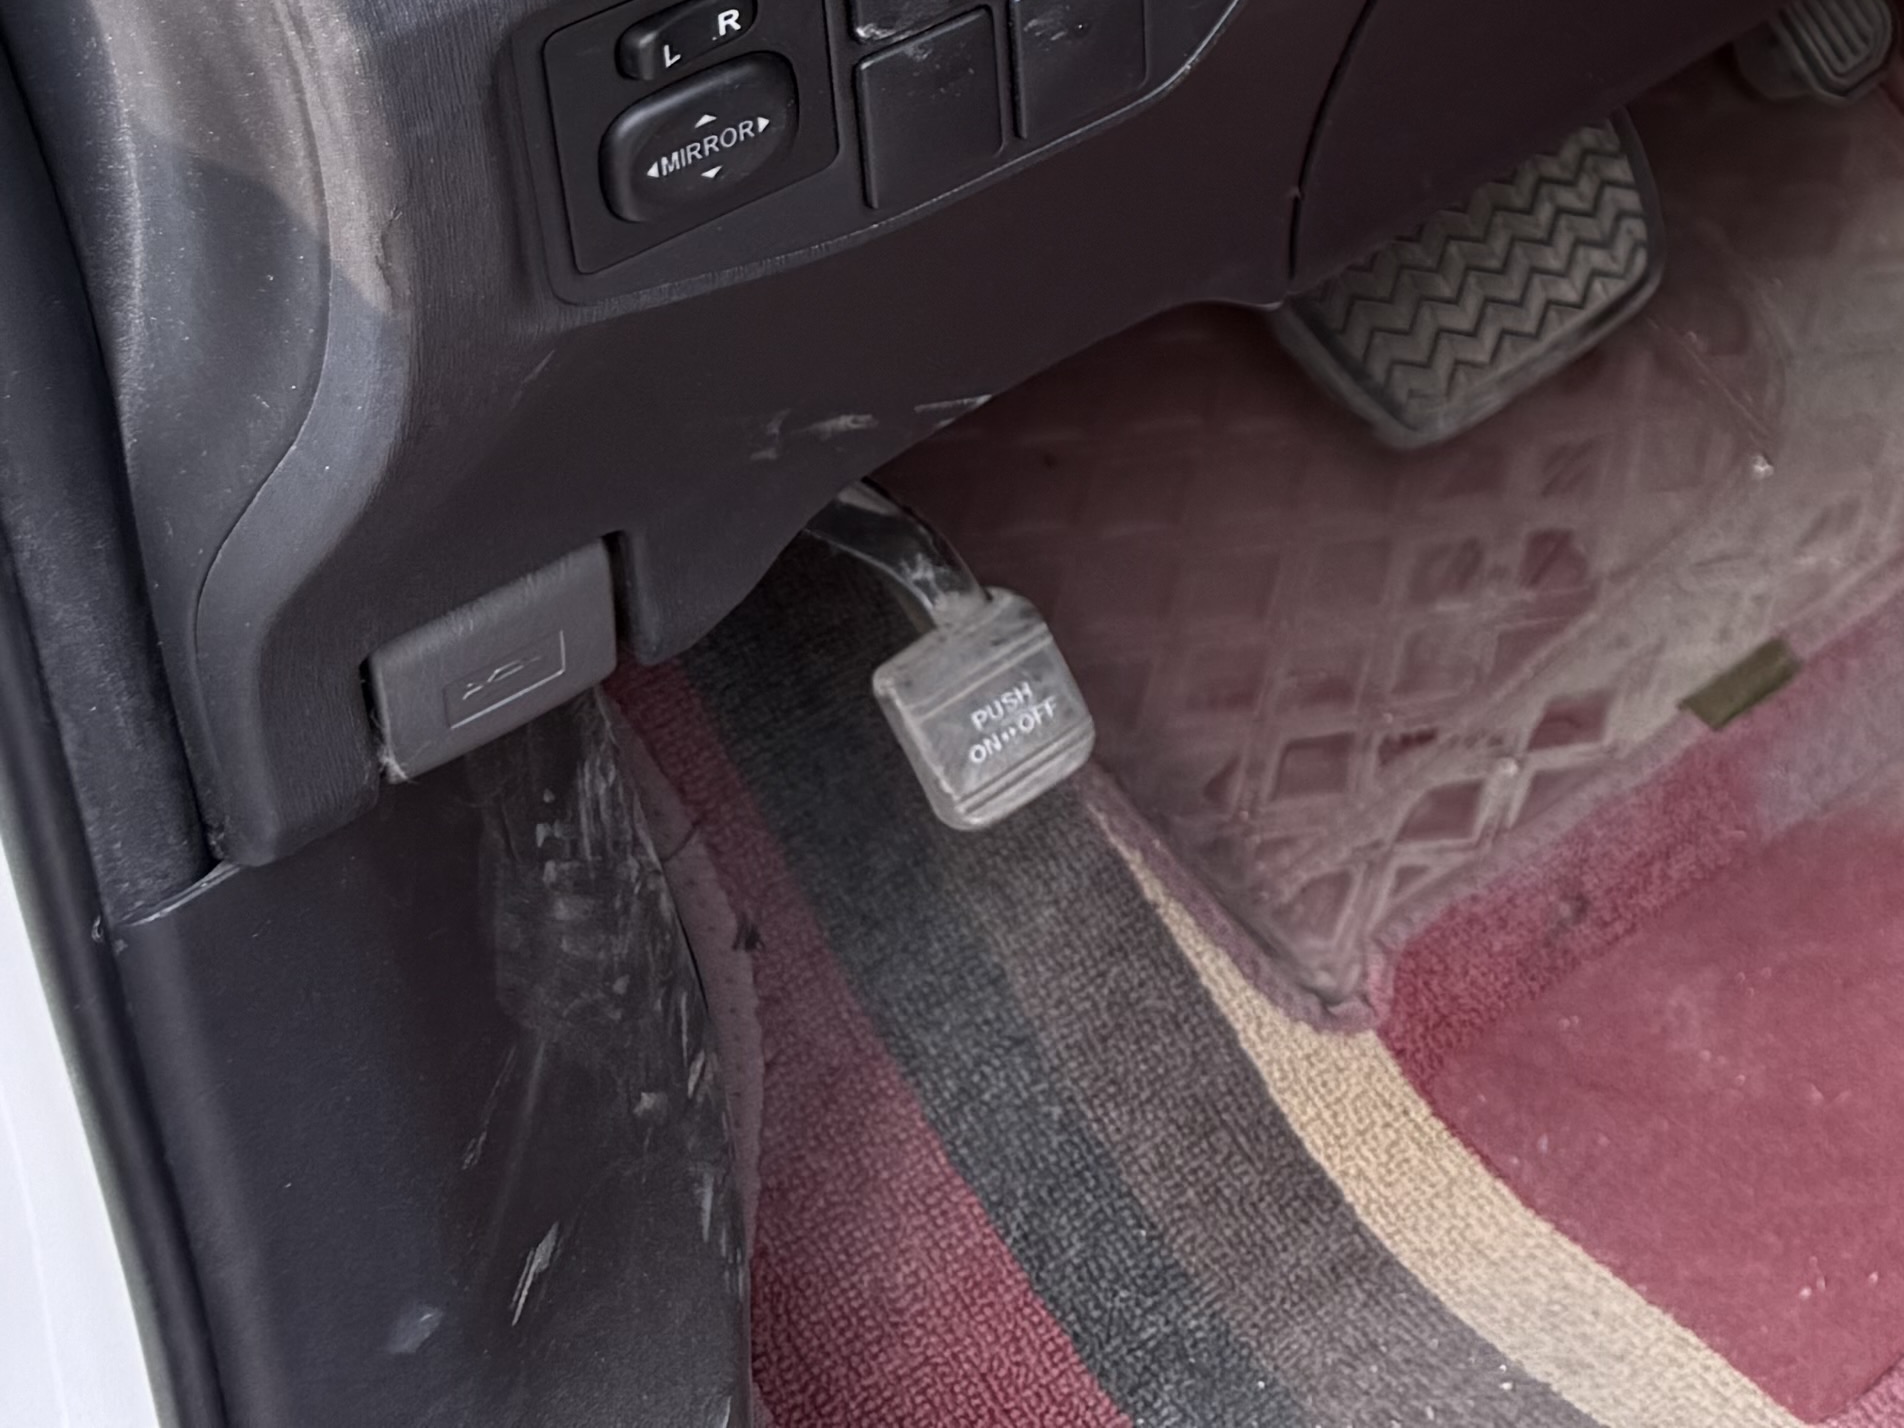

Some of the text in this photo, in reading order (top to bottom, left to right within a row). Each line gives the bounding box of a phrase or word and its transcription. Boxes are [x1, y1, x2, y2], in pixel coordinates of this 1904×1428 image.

[718, 7, 742, 37] R
[662, 44, 682, 69] L
[660, 119, 756, 178] MIRROR
[970, 681, 1034, 732] PUSH
